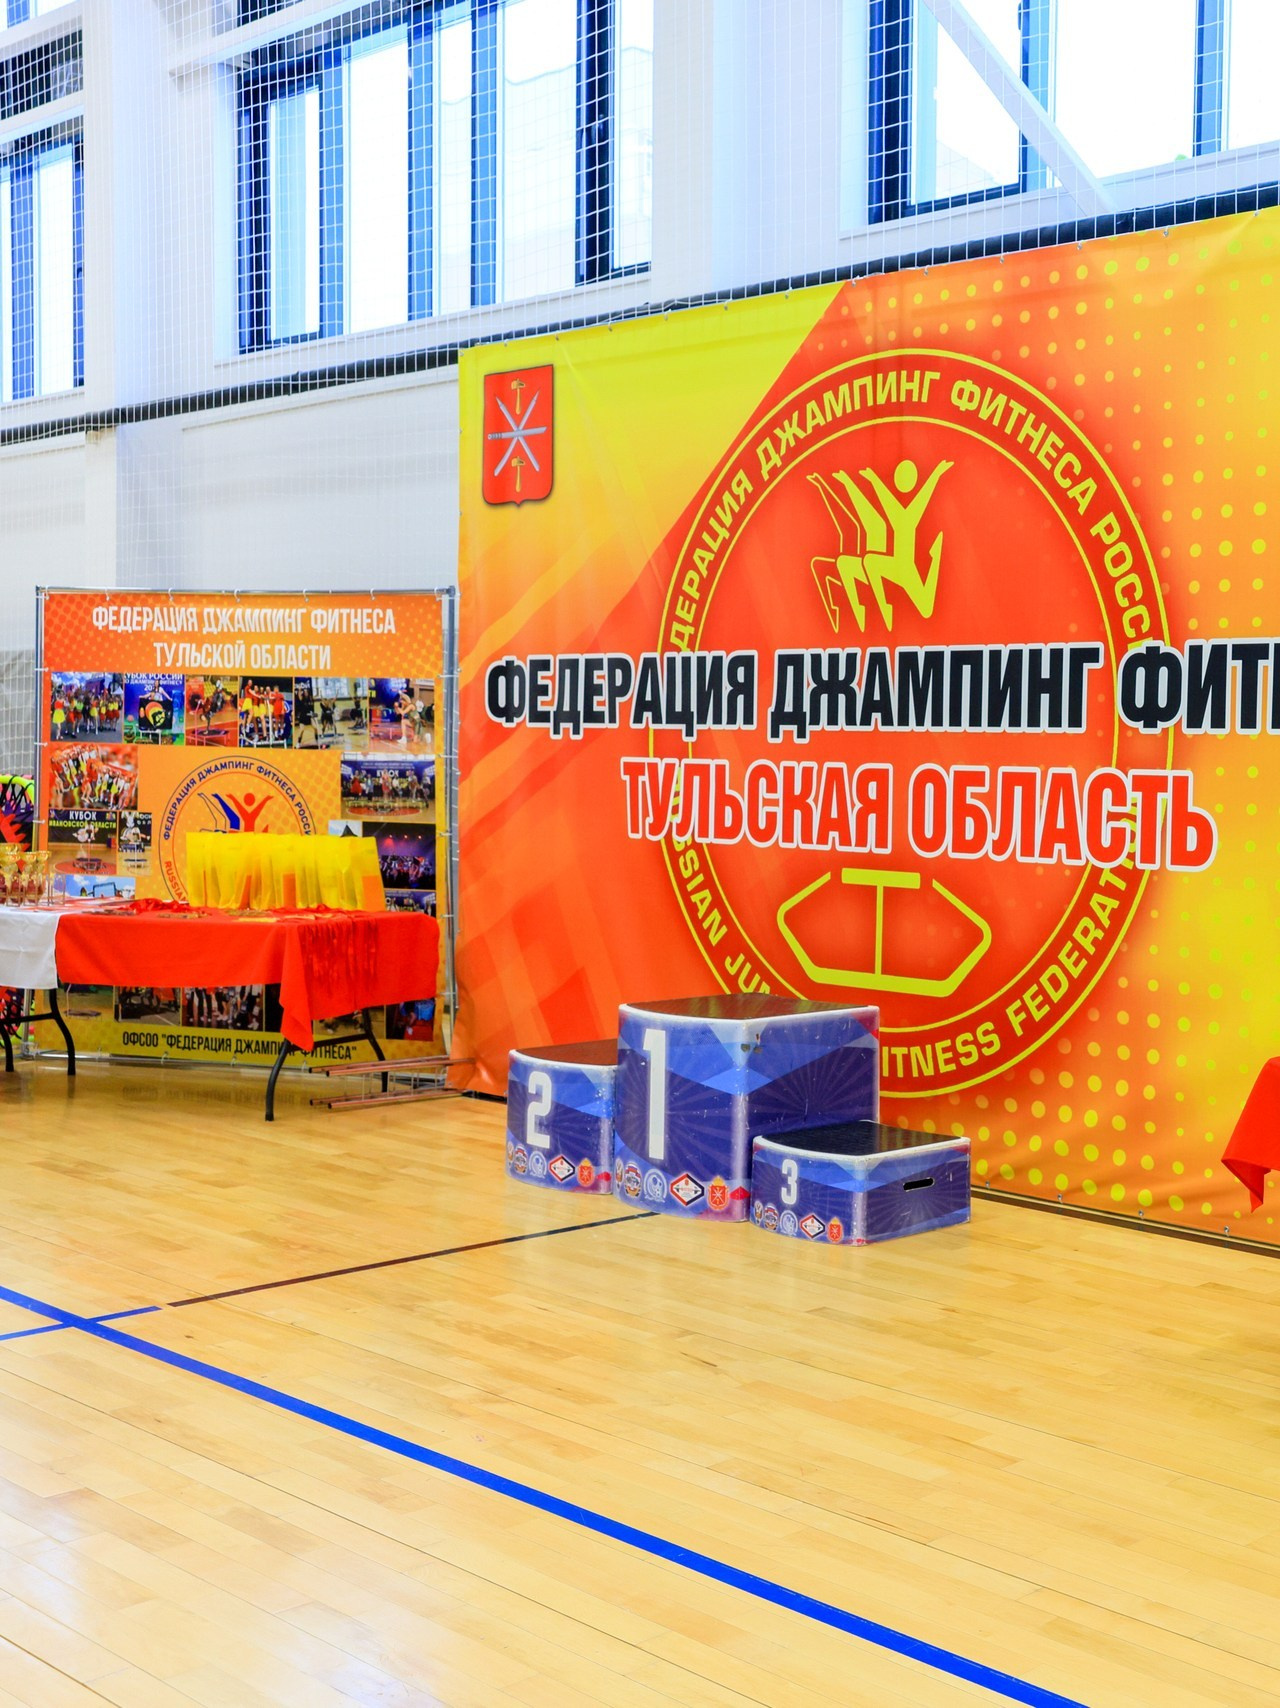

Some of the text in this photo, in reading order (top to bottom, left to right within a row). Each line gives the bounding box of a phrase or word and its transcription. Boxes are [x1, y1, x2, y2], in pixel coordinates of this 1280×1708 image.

[668, 370, 1153, 653] ДЕРАЦИЯ ДЖАМПИНГ ФИТНЕСА РОСС
[92, 605, 396, 635] ФЕДЕРАЦИЯ ДЖАМПИНГ ФИТНЕСА
[153, 639, 331, 670] ТУЛЬСКОЙ ОБЛАСТИ
[485, 649, 758, 742] ФЕДЕРАЦИЯ
[767, 642, 1104, 743] ДЖАМПИНГ
[69, 810, 97, 820] КУБОК
[163, 777, 197, 840] ФЕДЕРАЦИЯ
[197, 760, 254, 782] ДЖАМПИНГ
[256, 765, 296, 801] ФИТНЕСА
[620, 756, 1218, 872] ТУЛЬСКАЯ ОБЛАСТЬ
[123, 1031, 159, 1048] ОФСОО
[161, 1033, 232, 1053] "ФЕДЕРАЦИЯ
[882, 1021, 1001, 1078] ITNESS
[526, 1071, 552, 1149] 2
[642, 1028, 668, 1160] 1
[781, 1158, 798, 1205] 3
